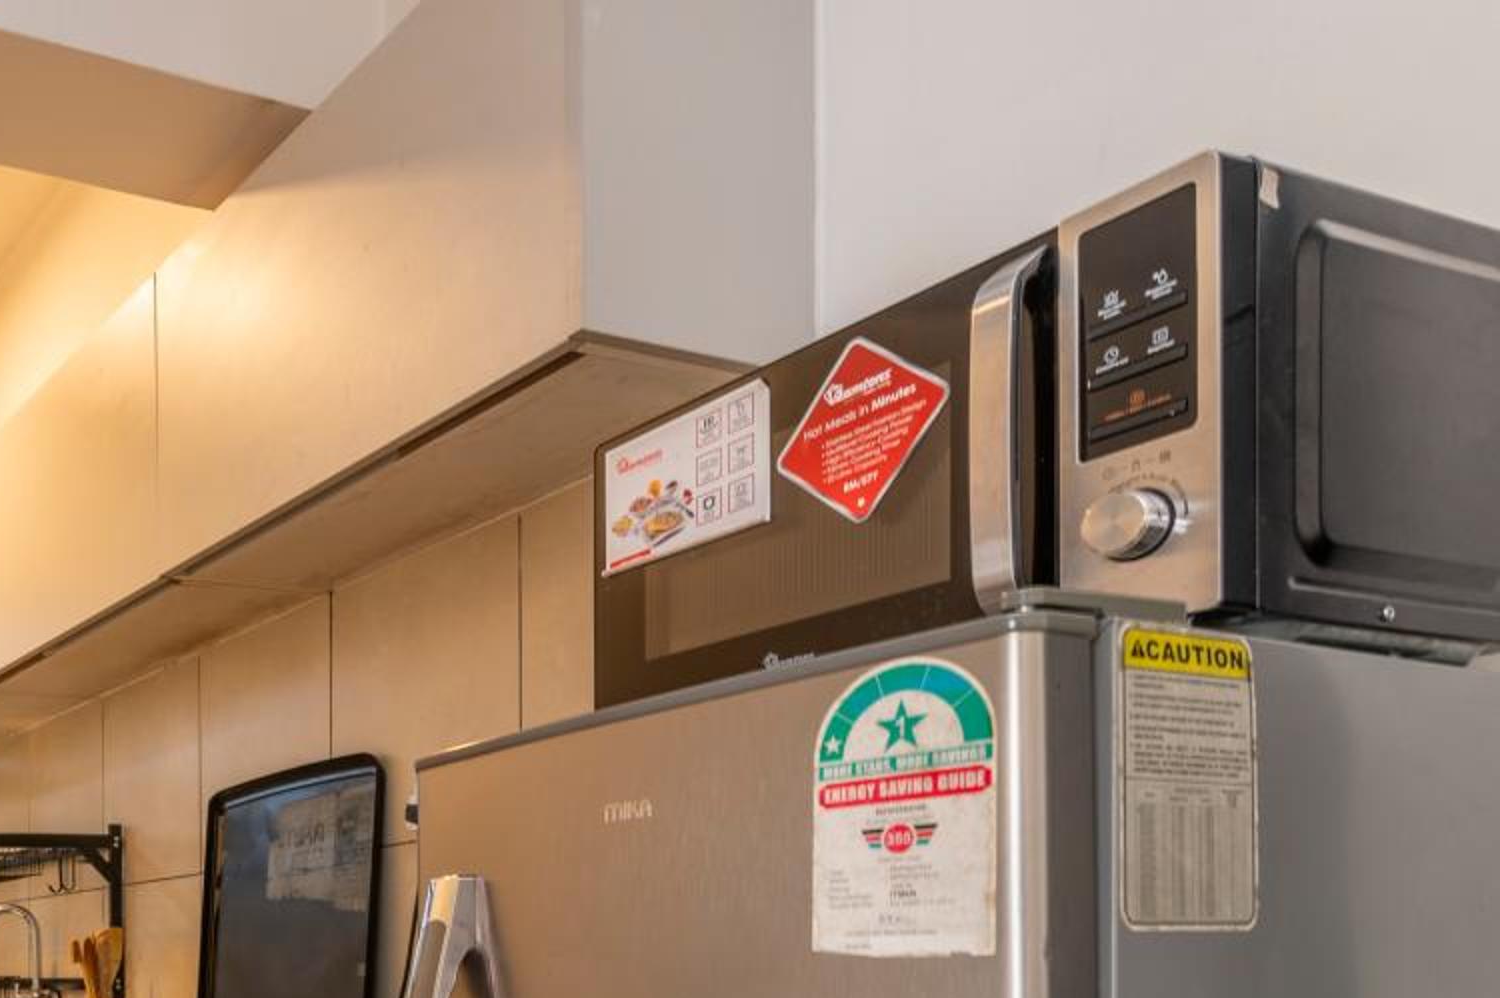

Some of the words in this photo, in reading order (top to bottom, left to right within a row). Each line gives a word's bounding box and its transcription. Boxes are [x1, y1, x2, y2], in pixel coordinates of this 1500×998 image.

[803, 425, 823, 442] Hot
[824, 411, 857, 432] Meals
[859, 402, 870, 418] in
[871, 383, 918, 413] Minutes
[824, 782, 876, 805] ENERGY
[879, 775, 933, 798] SAVING
[937, 769, 985, 792] GUIDE
